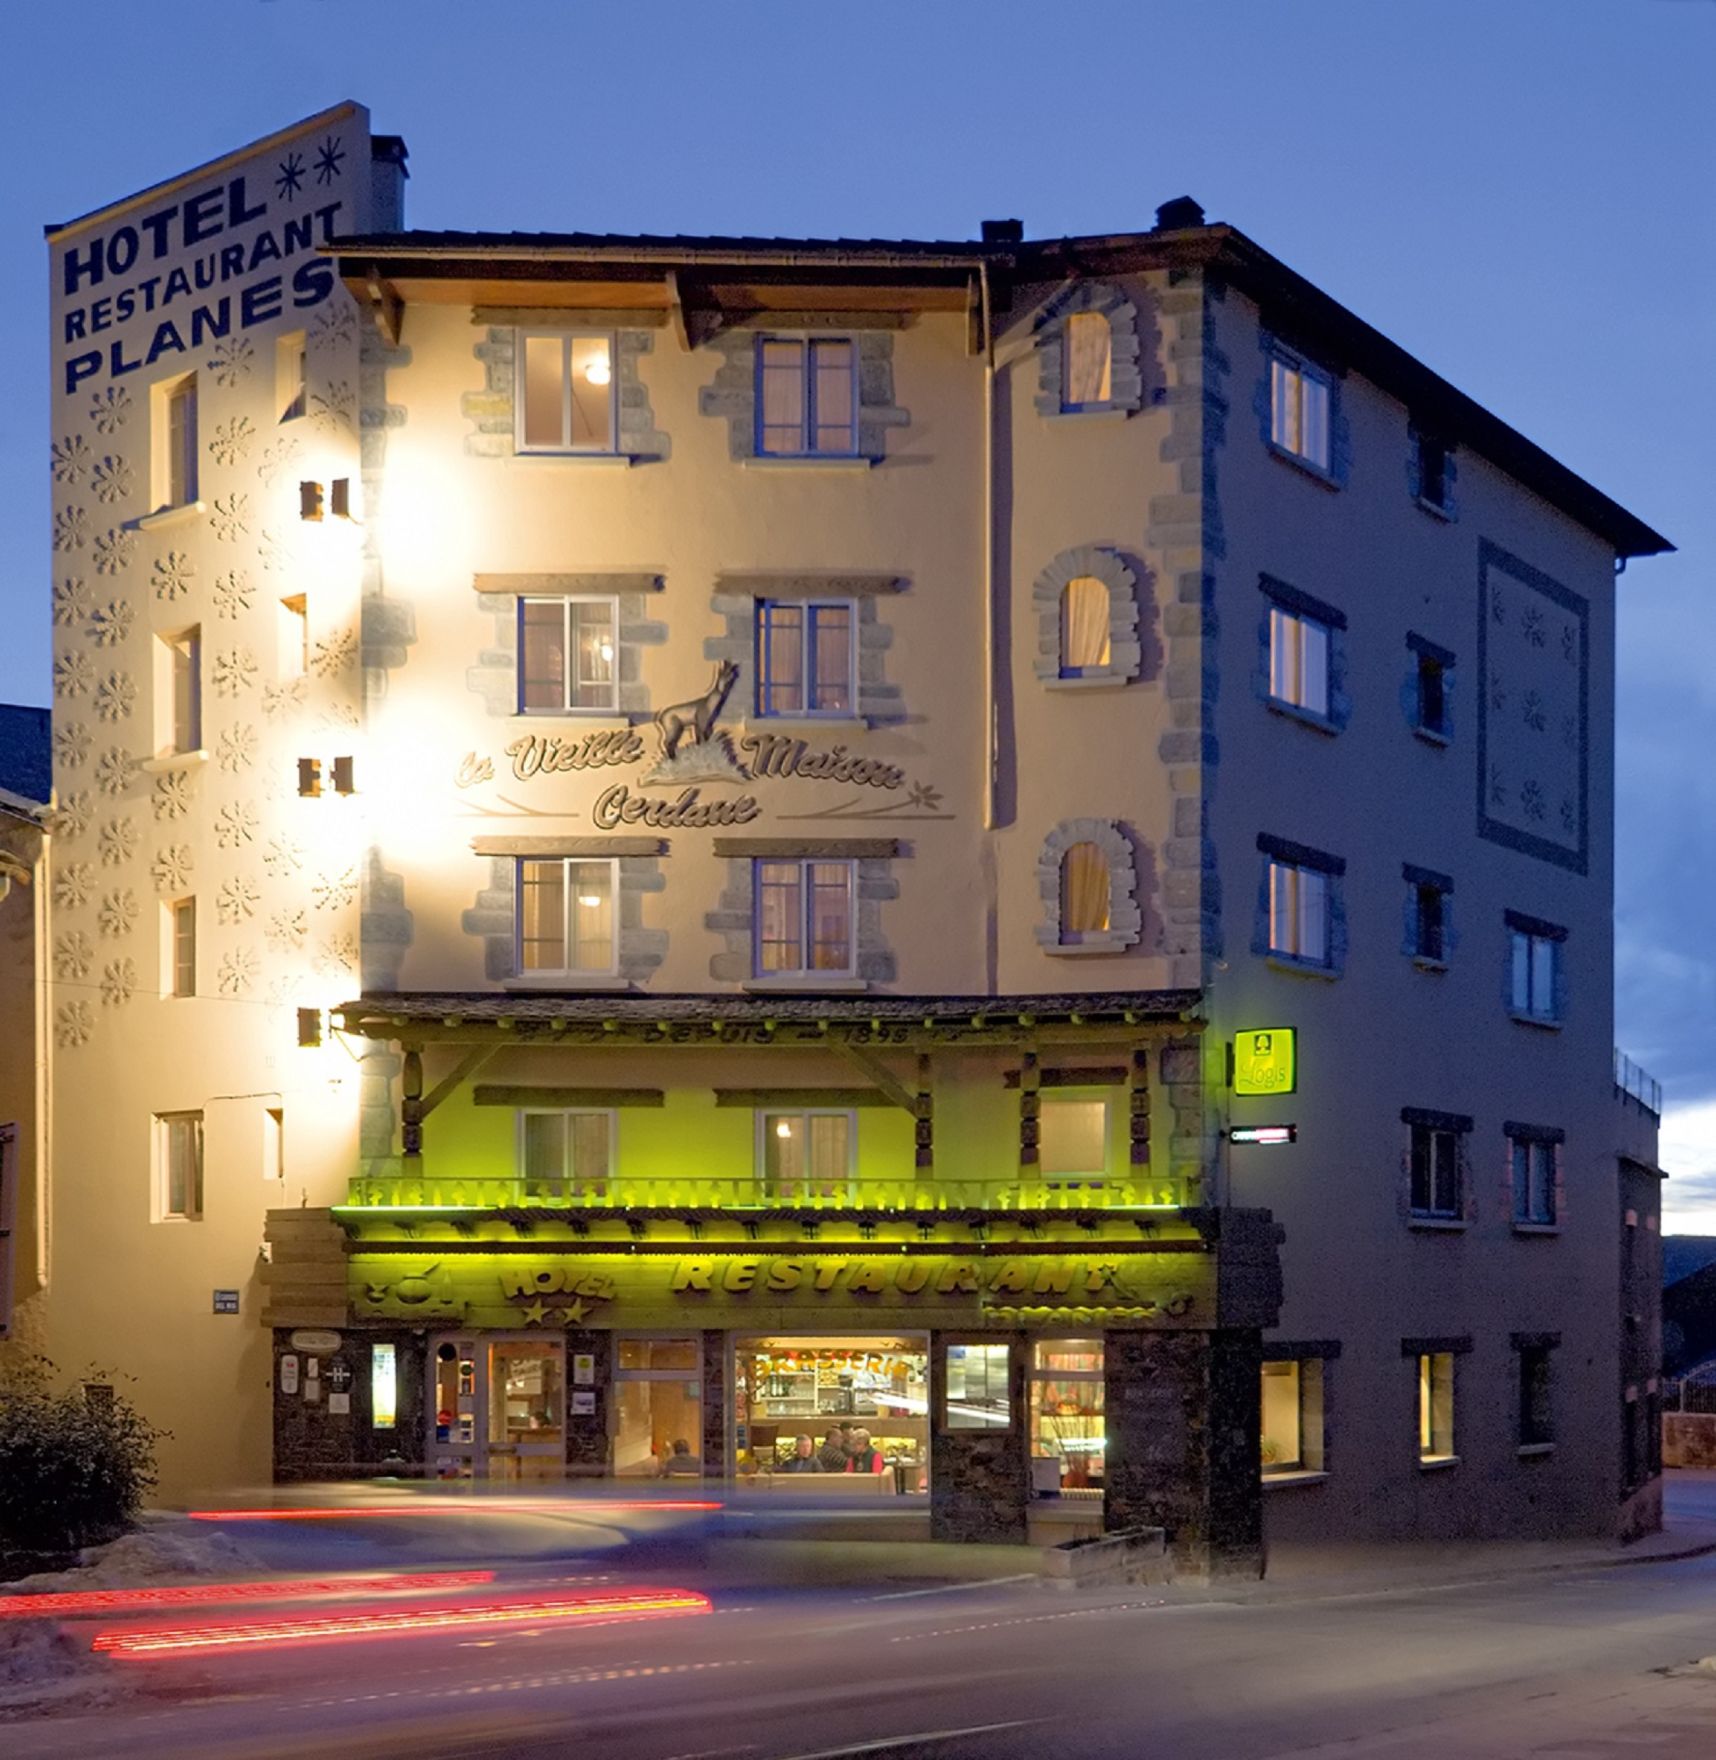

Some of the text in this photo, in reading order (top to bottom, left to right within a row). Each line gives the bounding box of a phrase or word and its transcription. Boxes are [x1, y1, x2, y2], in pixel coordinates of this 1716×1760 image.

[63, 175, 267, 296] HOTEL
[64, 200, 343, 344] RESTAURANT
[64, 256, 335, 396] PLANES
[504, 729, 646, 782] Vieille
[740, 732, 905, 790] Maison
[592, 782, 762, 830] Cerdane
[1240, 1056, 1286, 1089] Logis
[498, 1267, 616, 1302] HOTEL
[671, 1255, 1119, 1294] RESTAURANT
